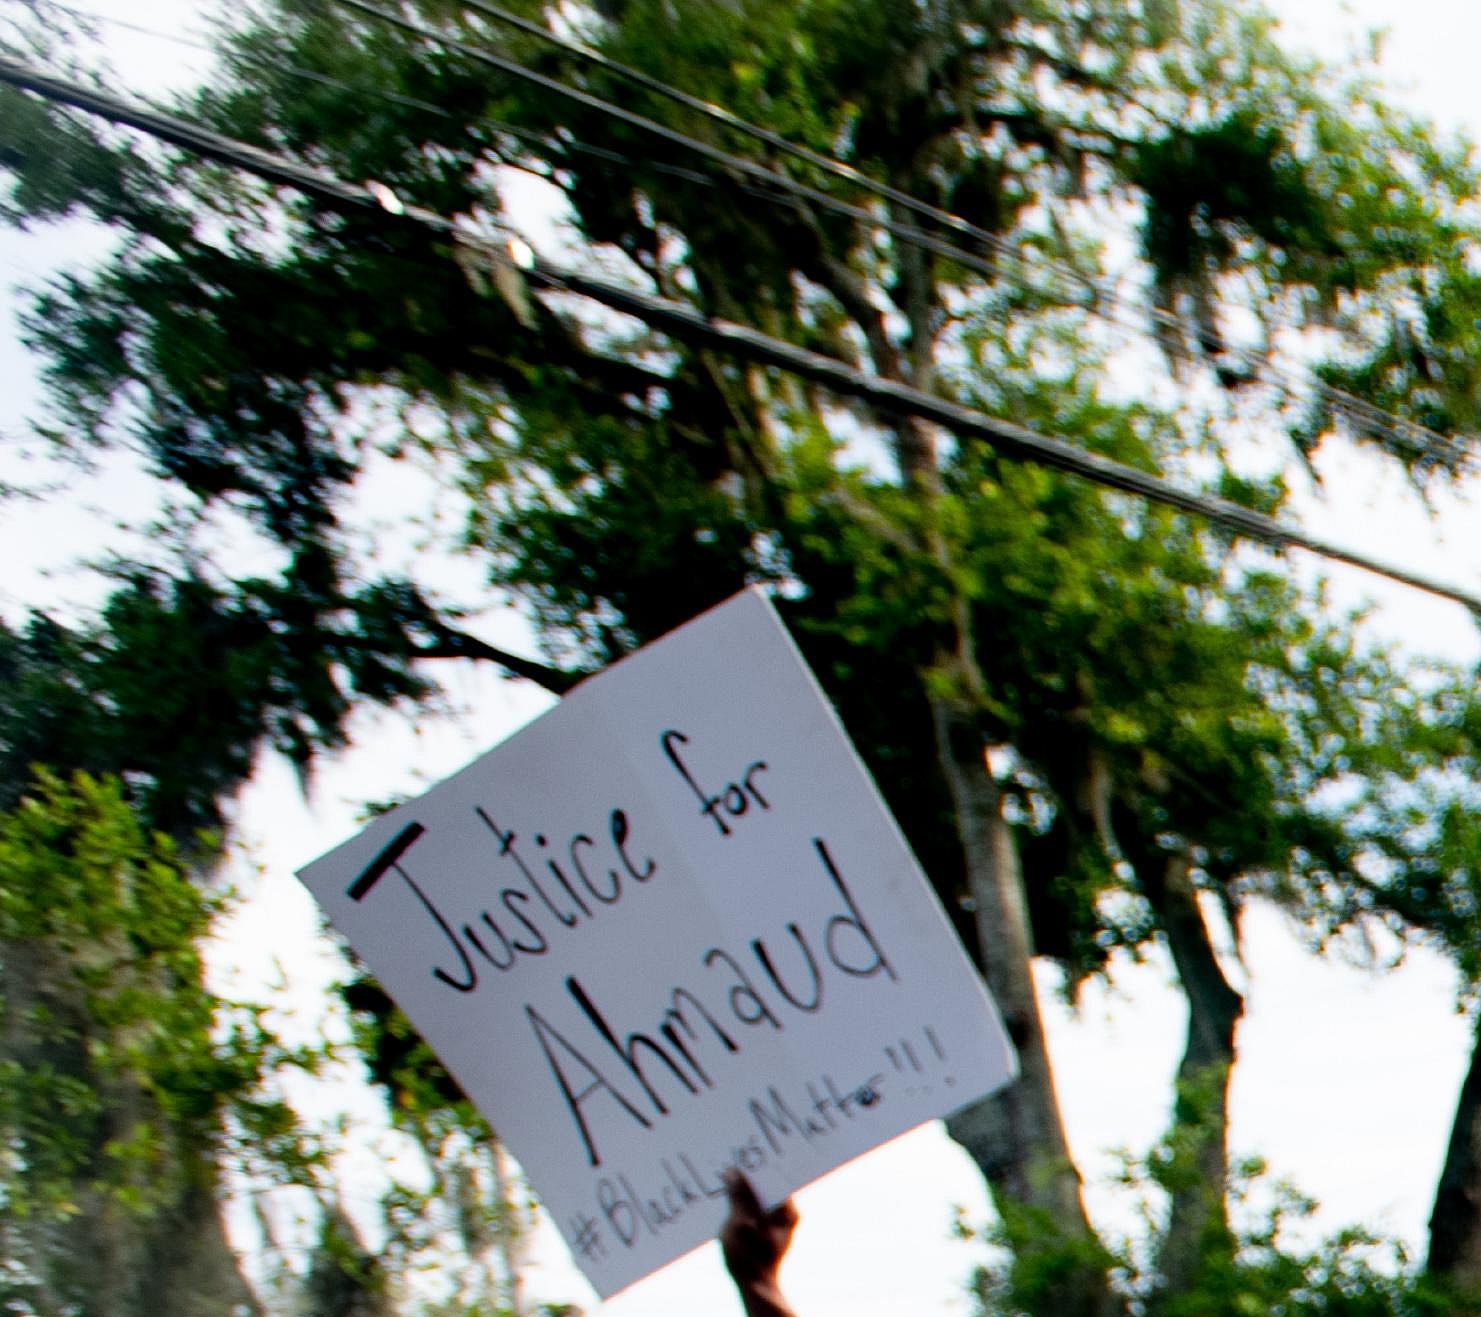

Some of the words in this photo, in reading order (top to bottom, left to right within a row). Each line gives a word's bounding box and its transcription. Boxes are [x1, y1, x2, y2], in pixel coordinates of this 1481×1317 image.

[347, 806, 656, 993] Justice
[661, 728, 769, 838] for
[525, 837, 899, 1167] Ahmaud
